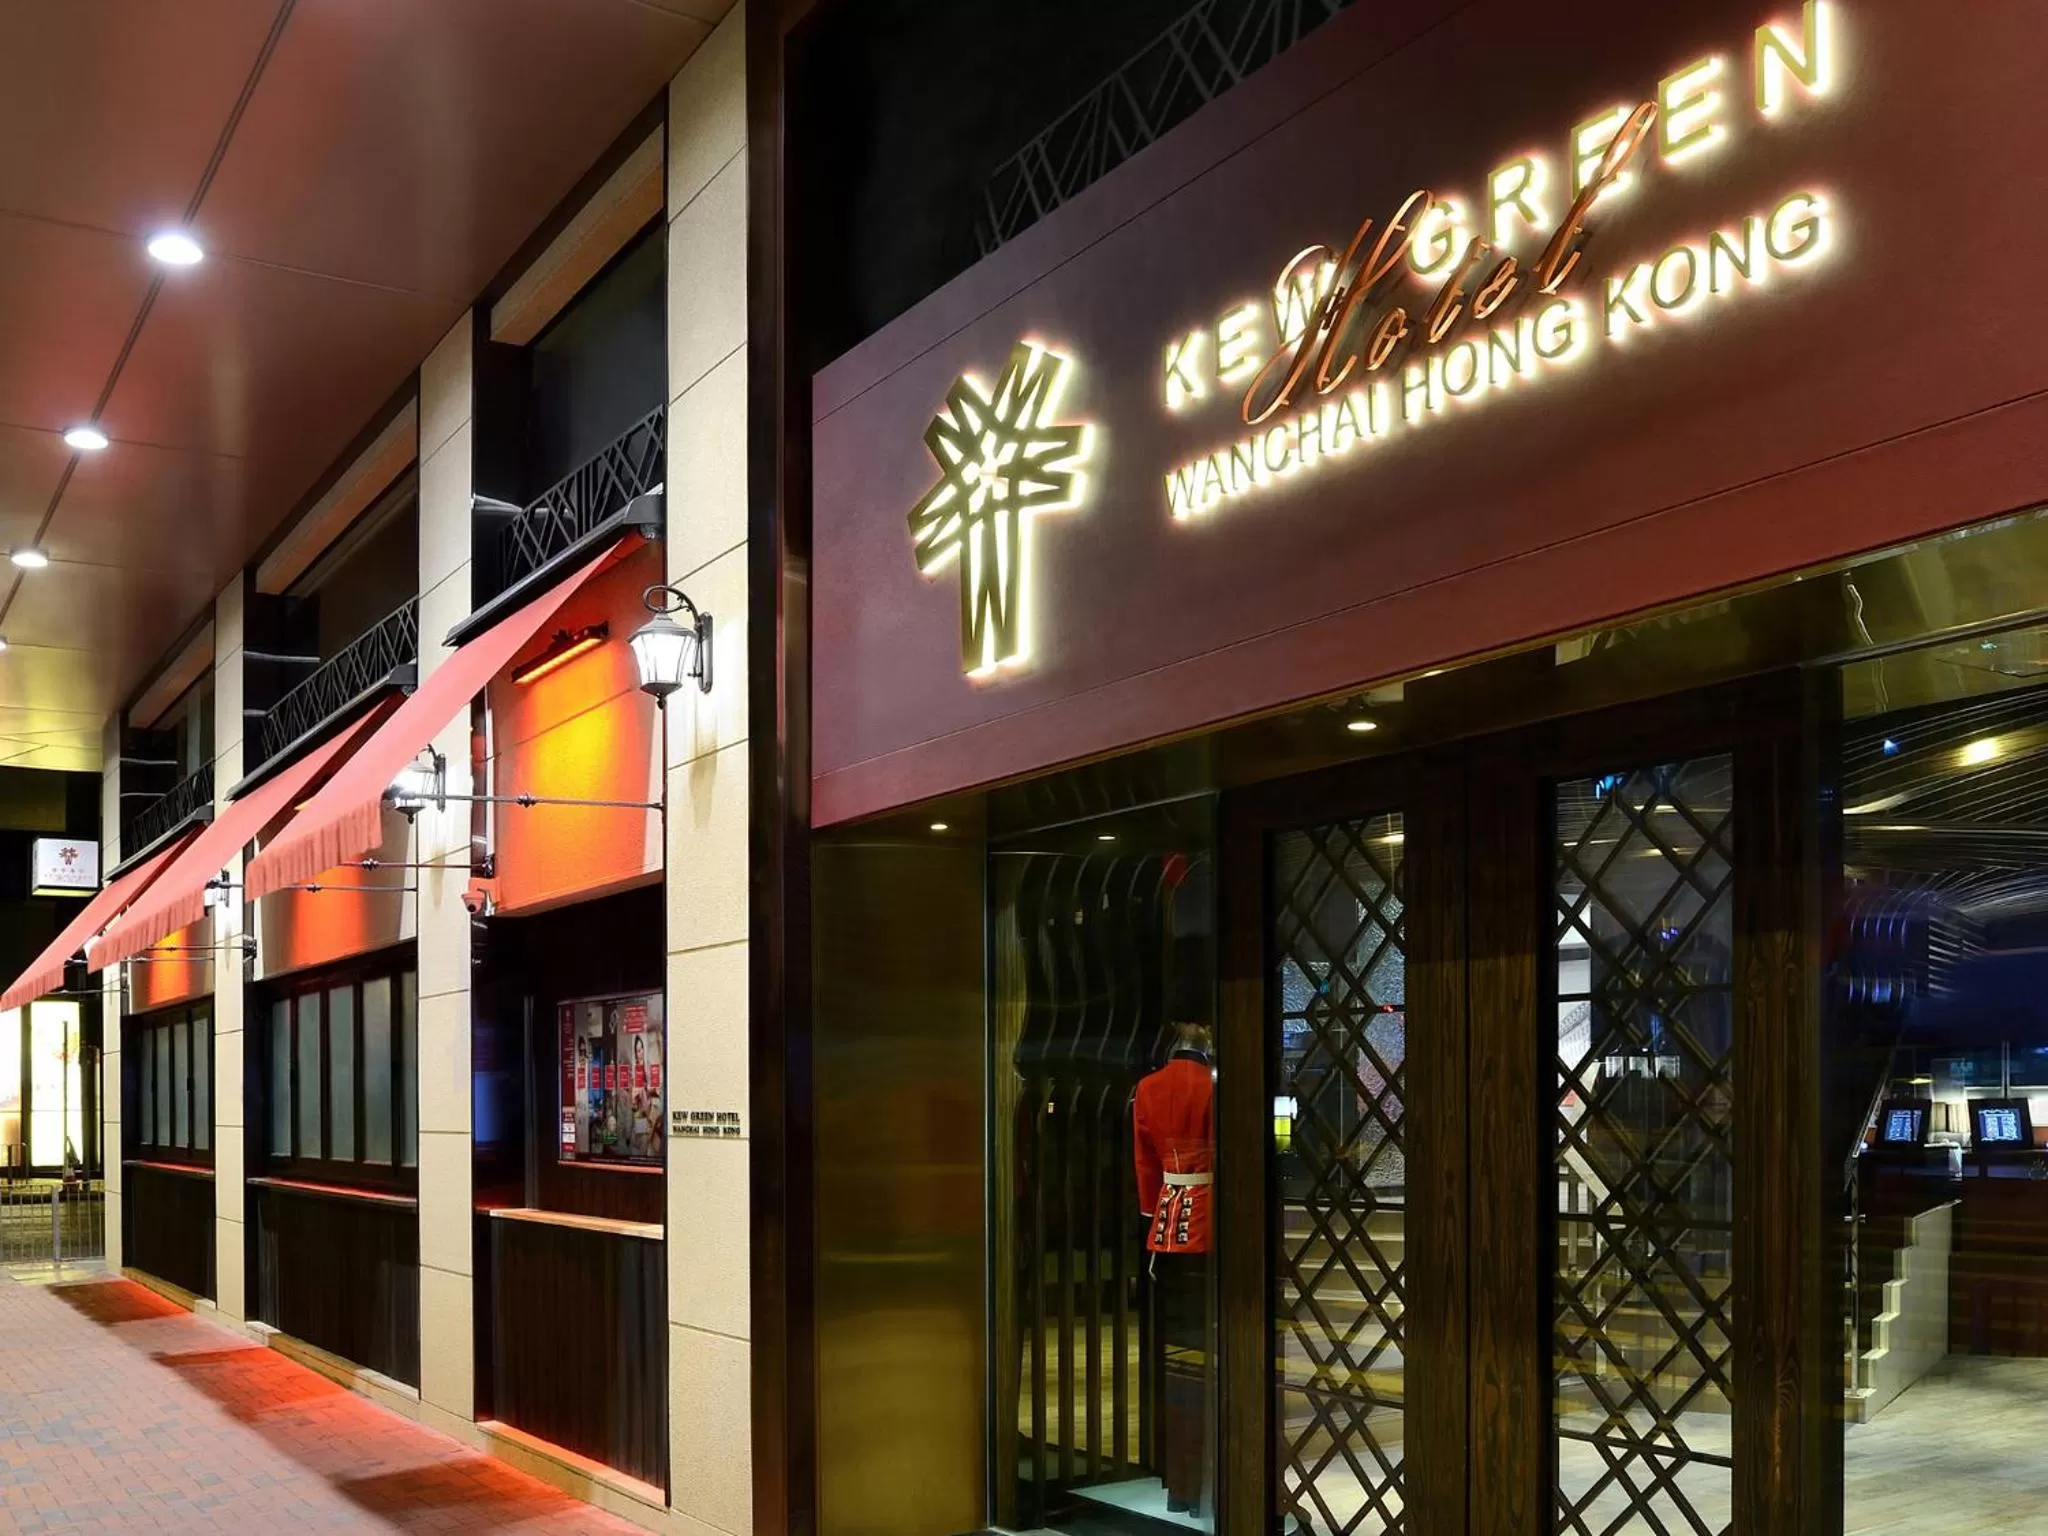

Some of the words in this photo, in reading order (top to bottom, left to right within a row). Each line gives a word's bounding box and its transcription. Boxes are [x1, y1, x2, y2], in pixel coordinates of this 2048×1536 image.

[1162, 259, 1344, 409] KEW
[1407, 0, 1832, 278] GREEN
[1163, 380, 1388, 519] WANCHAI
[1402, 298, 1584, 423] HONG
[1603, 191, 1828, 341] KONG
[1241, 100, 1658, 425] Hotel
[672, 1111, 689, 1121] KEW
[690, 1111, 715, 1122] GREEN
[716, 1112, 740, 1123] HOTEL
